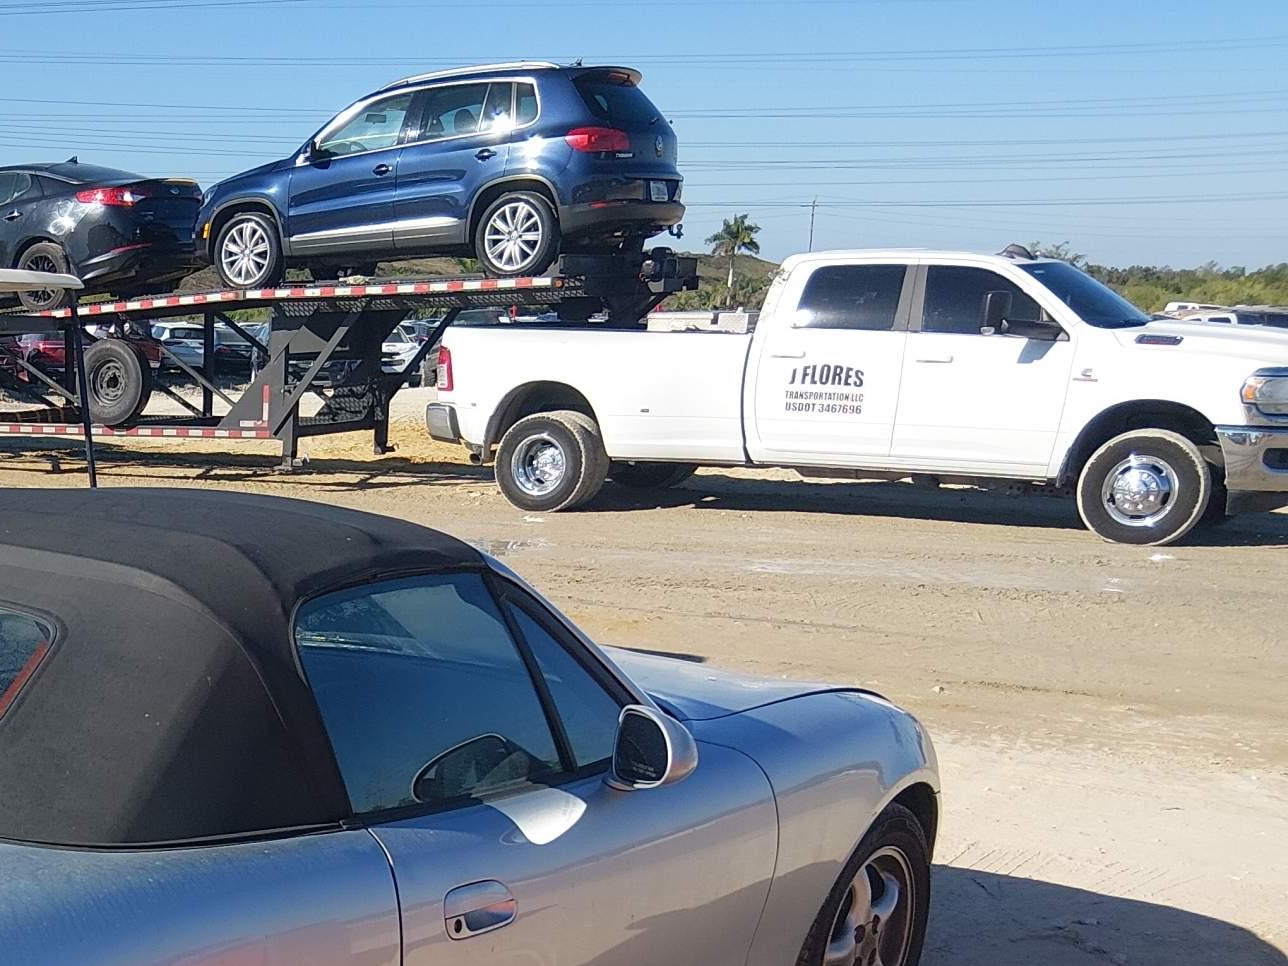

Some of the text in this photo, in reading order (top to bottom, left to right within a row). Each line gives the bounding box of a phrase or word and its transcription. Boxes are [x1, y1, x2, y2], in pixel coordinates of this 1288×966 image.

[789, 364, 864, 387] J FLORES
[785, 391, 864, 402] TRANSPORTATION LLC
[785, 402, 862, 415] USDOT 3467696
